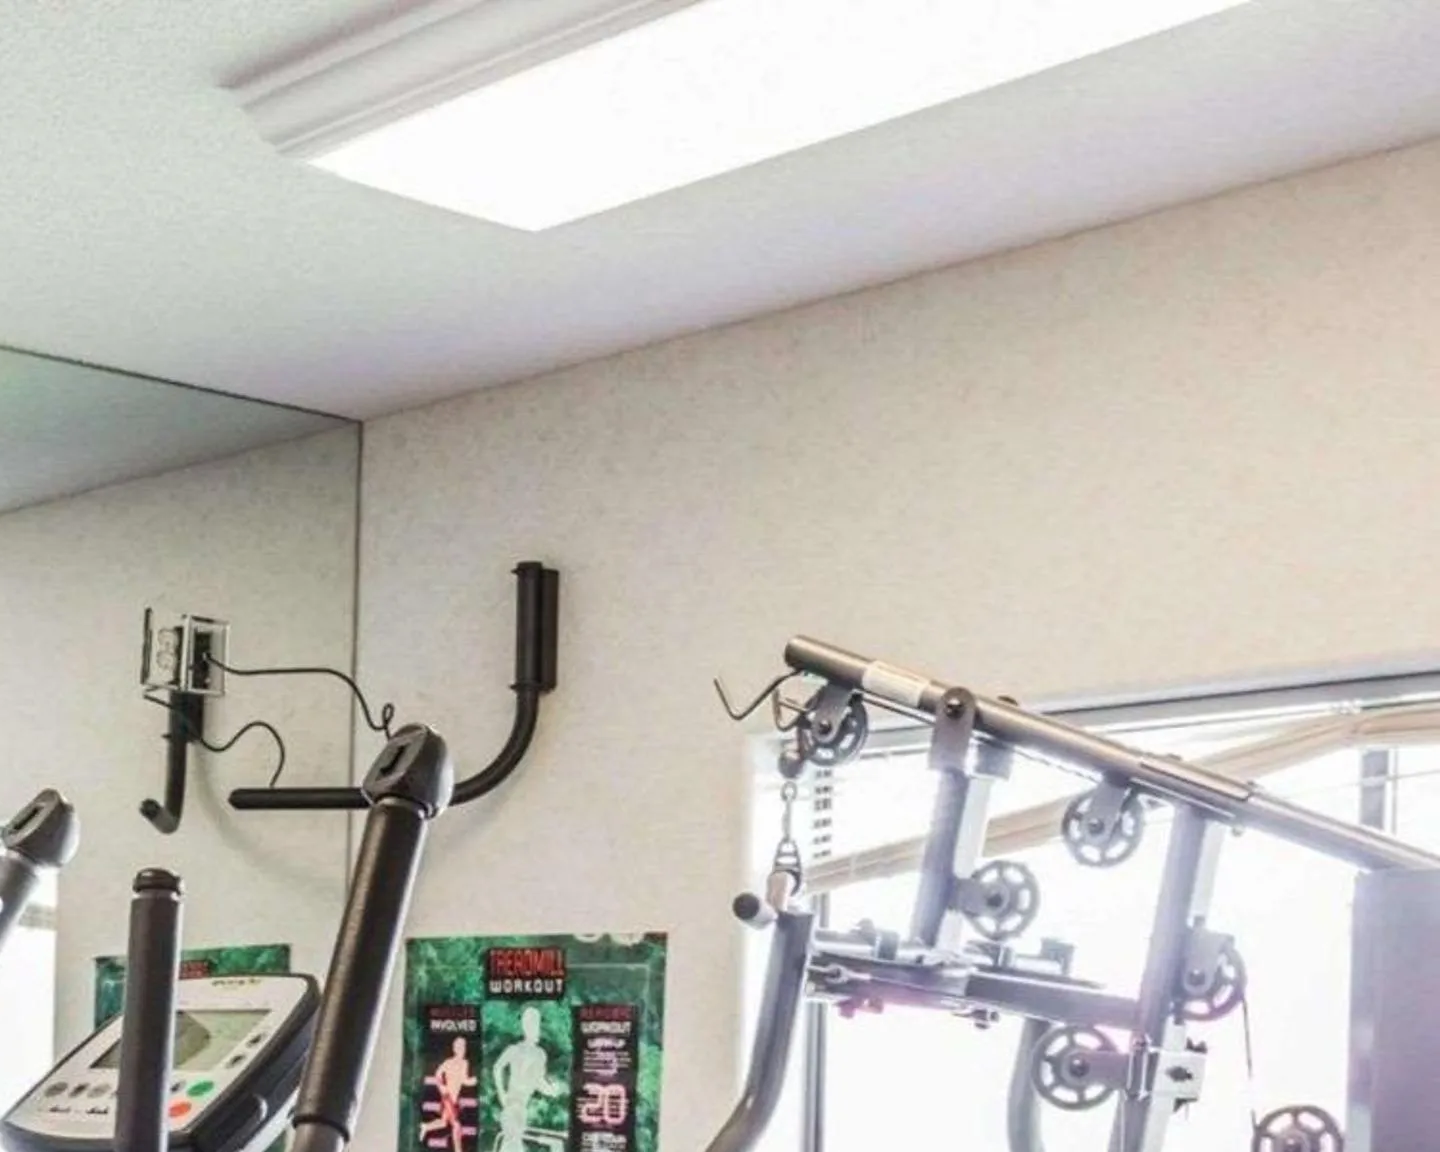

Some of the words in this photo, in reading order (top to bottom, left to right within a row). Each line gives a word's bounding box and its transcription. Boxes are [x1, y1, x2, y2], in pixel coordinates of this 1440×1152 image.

[489, 948, 565, 977] TREADMILL
[489, 978, 564, 994] WORKOUT
[430, 1019, 477, 1032] INVOLVED
